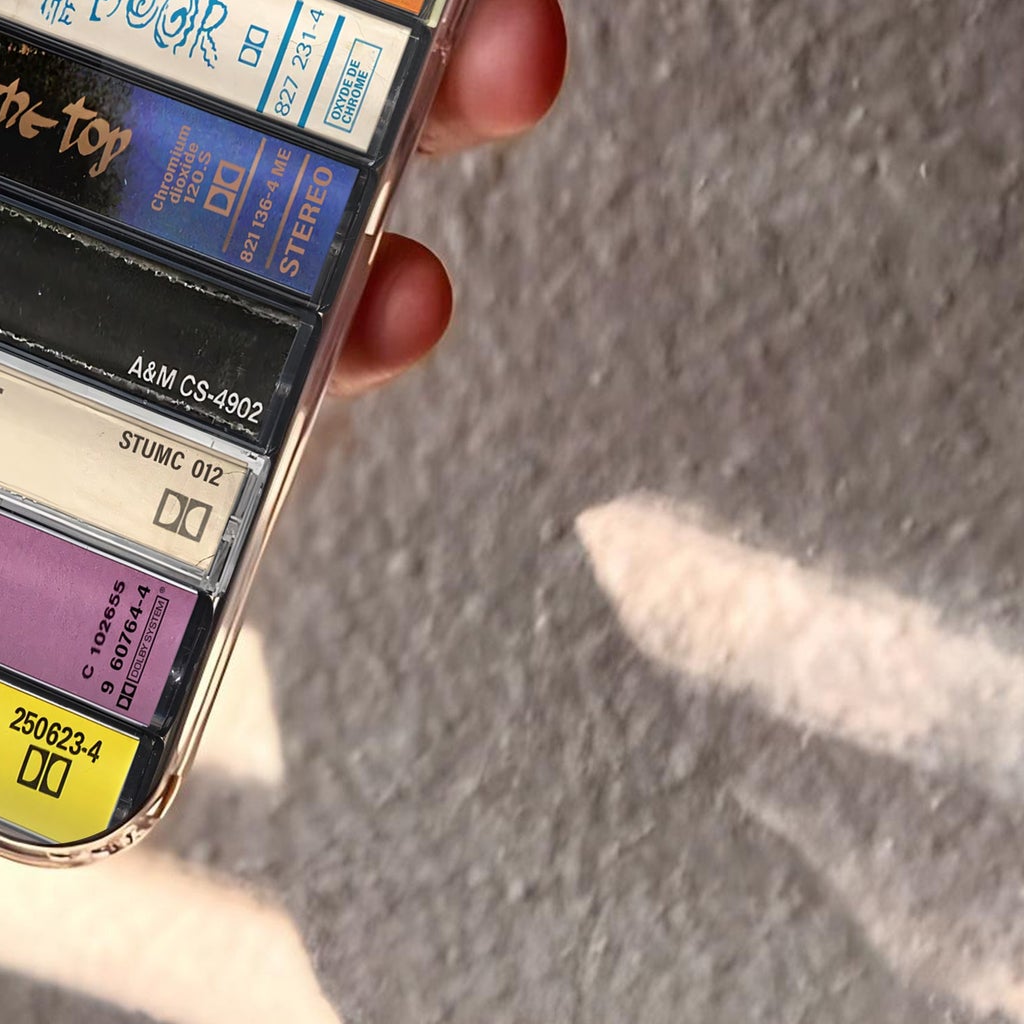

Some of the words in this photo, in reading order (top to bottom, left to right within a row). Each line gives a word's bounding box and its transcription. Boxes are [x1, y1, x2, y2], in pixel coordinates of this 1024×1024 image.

[275, 75, 298, 116] 827
[291, 9, 325, 70] 231-4
[331, 78, 354, 120] OXYDE
[347, 59, 361, 79] DE
[342, 70, 368, 124] CHROME
[58, 96, 132, 177] top
[151, 125, 192, 211] Chromium
[169, 142, 199, 204] dioxide
[183, 151, 212, 204] 120.S
[240, 232, 260, 263] 821
[252, 180, 280, 229] 136-4
[271, 147, 292, 177] ME
[279, 166, 333, 277] STEREO
[127, 356, 179, 391] A&M
[179, 374, 264, 424] CS-4902
[119, 430, 185, 471] STUMC
[191, 459, 224, 487] 012
[82, 664, 94, 679] C
[90, 580, 125, 655] 102655
[101, 680, 114, 695] 9
[110, 585, 151, 671] 60764-4
[131, 643, 149, 678] DOLBY
[145, 600, 165, 643] SYSTEM
[10, 707, 103, 763] 250623-4
